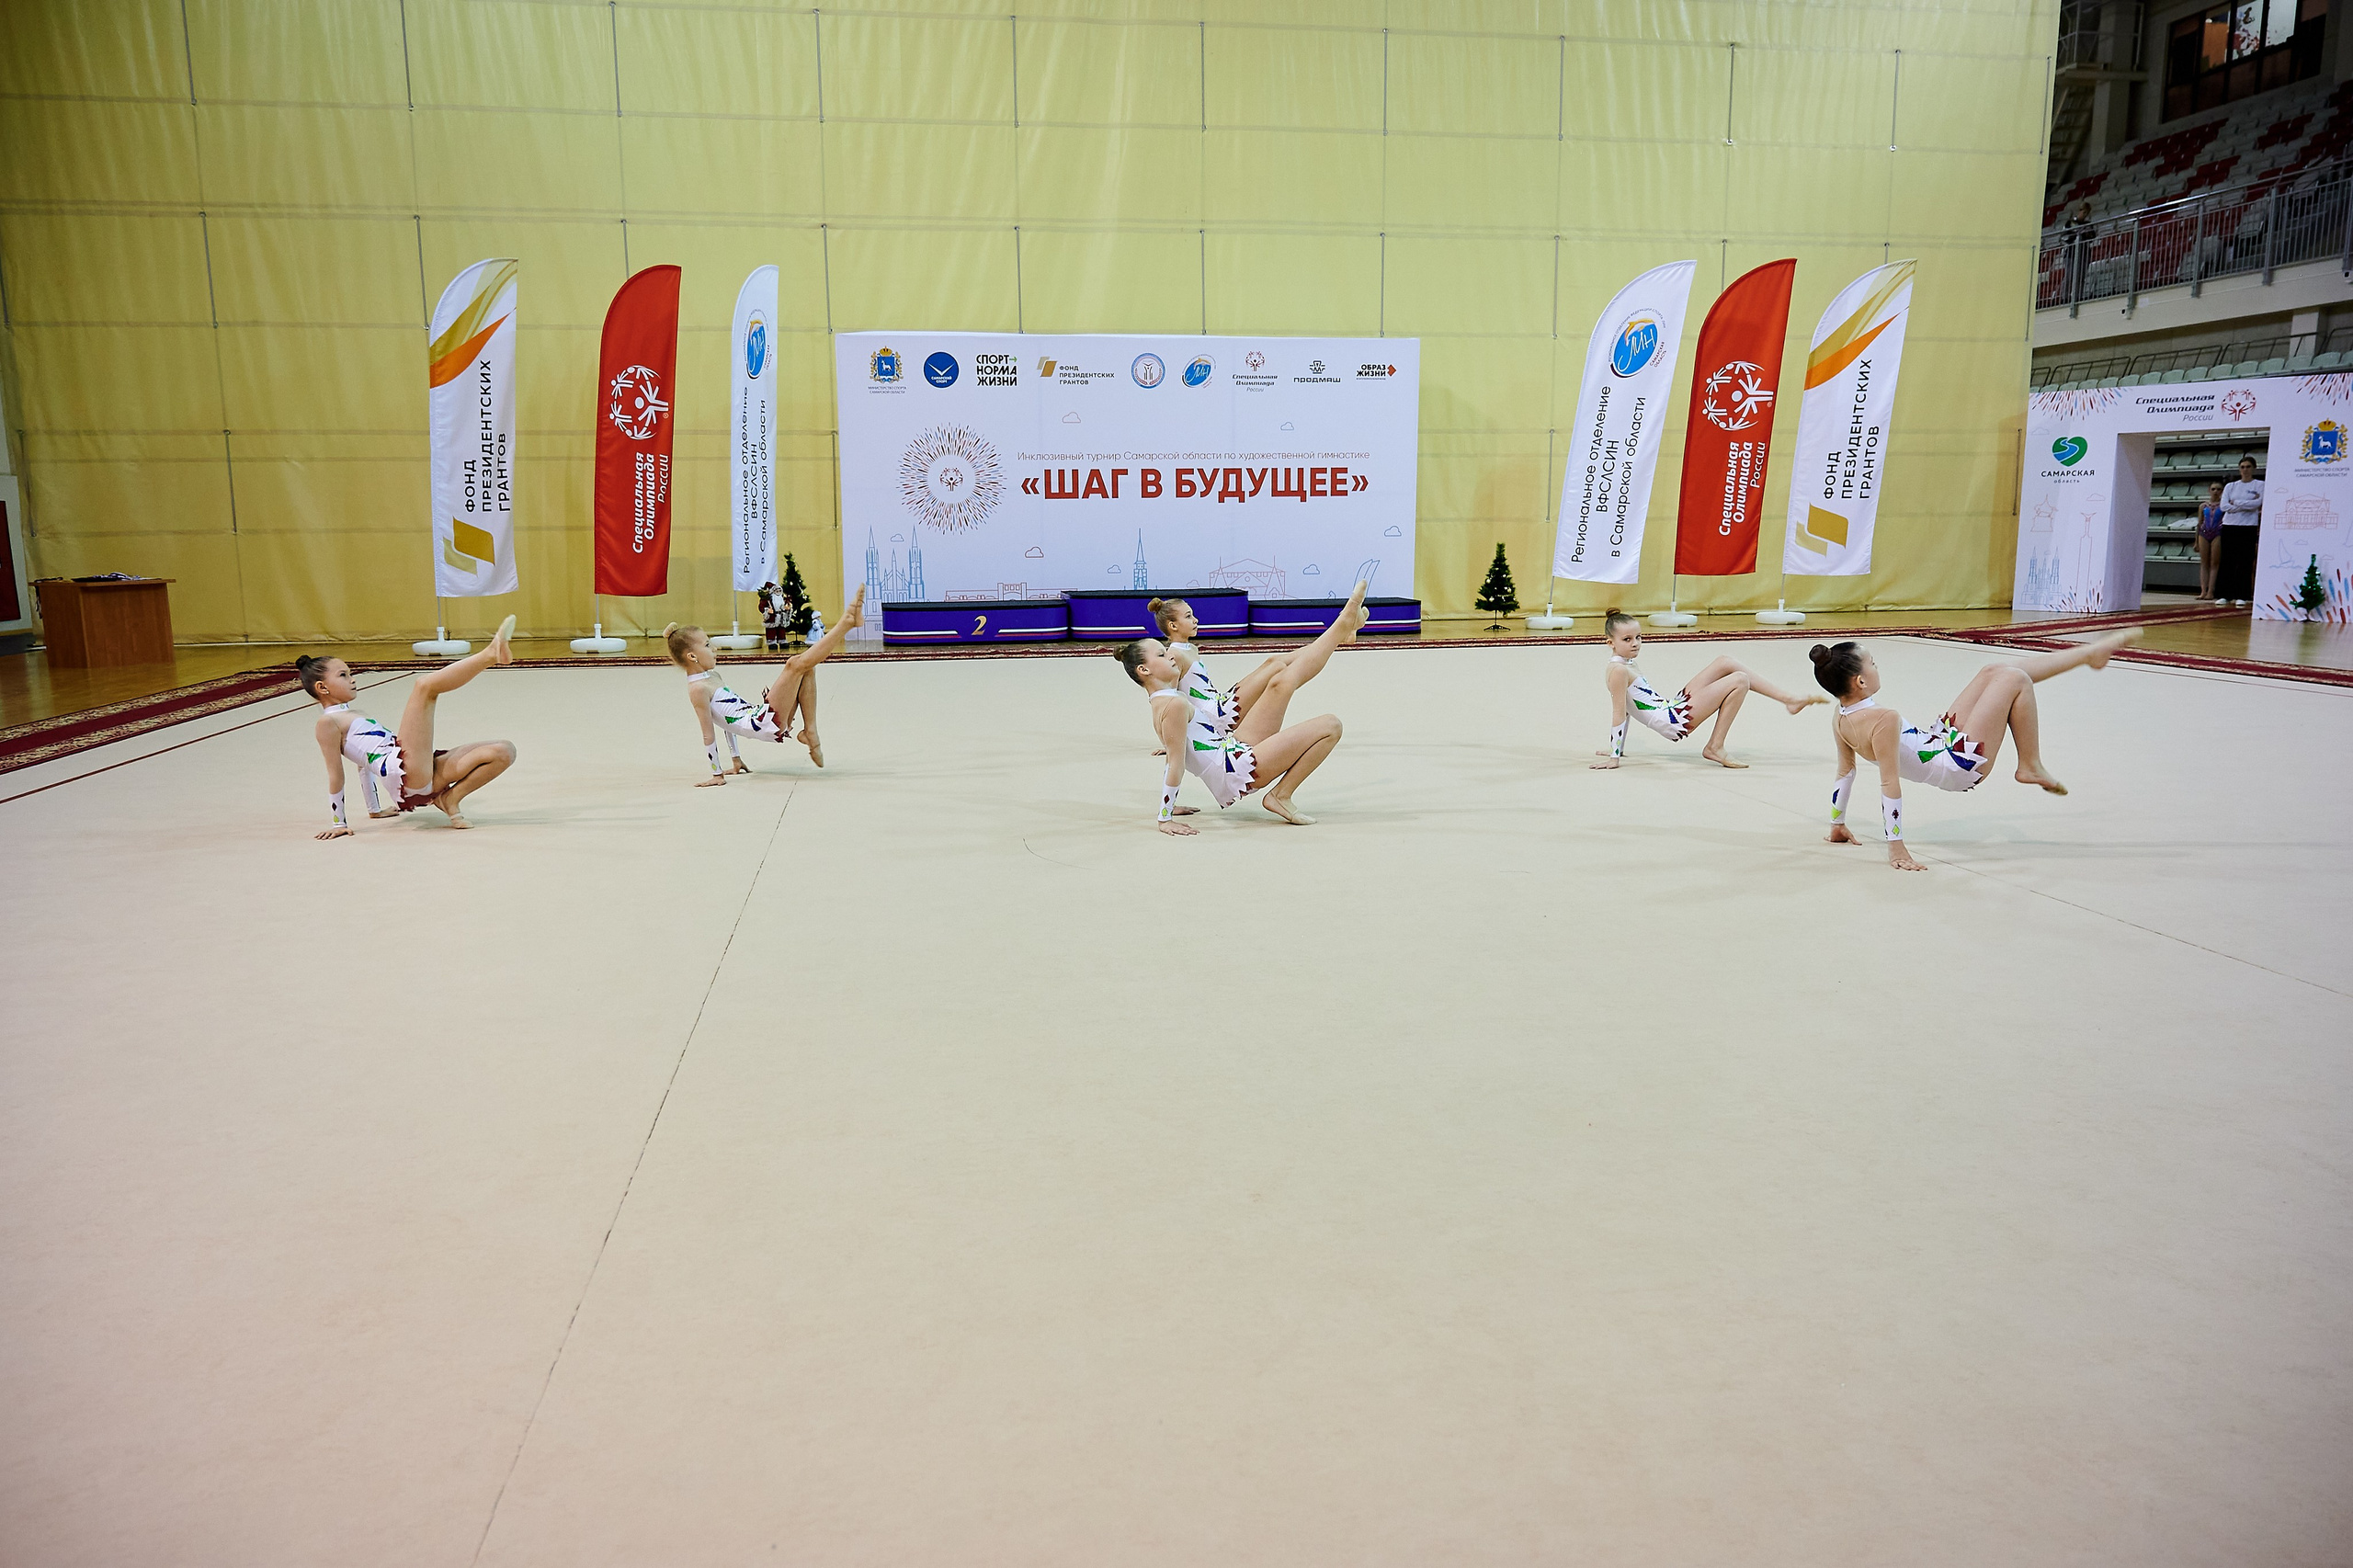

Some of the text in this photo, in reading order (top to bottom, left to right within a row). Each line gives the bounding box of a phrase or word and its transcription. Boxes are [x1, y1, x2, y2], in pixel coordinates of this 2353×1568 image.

[976, 355, 1010, 365] СПОРТ
[976, 366, 1017, 375] НОРМА
[977, 377, 1017, 386] ЖИЗНИ
[1841, 359, 1872, 499] ПРЕЗИДЕНТСКИХ
[2135, 394, 2215, 404] Специальная
[2146, 404, 2214, 414] Олимпиада
[2182, 414, 2213, 422] России
[480, 360, 494, 512] ПРЕЗИДЕНТСКИХ
[758, 400, 767, 460] области
[1017, 451, 1084, 460] Инклюзивный
[1087, 453, 1121, 461] турнир
[1124, 451, 1180, 461] Самарской
[1182, 450, 1222, 460] области
[1238, 450, 1315, 461] художественной
[1317, 451, 1370, 460] гимнастике
[464, 460, 477, 513] ФОНД
[496, 433, 511, 512] ГРАНТОВ
[657, 454, 668, 503] России
[750, 443, 758, 519] ВФСЛСИН
[1020, 467, 1370, 503] «ШАГ В БУДУЩЕЕ»
[1571, 386, 1611, 562] Региональное отделение
[1596, 440, 1620, 513] ВФСЛСИН
[1609, 460, 1633, 546] Самарской
[1625, 396, 1646, 457] области
[1719, 441, 1740, 536] Специальная
[1733, 441, 1753, 523] Олимпиада
[1750, 441, 1766, 488] России
[1824, 451, 1841, 499] ФОНД
[1859, 426, 1880, 498] ГРАНТОВ
[632, 451, 644, 553] Специальная
[643, 453, 655, 540] Олимпиада
[759, 465, 769, 552] Самарской
[971, 616, 987, 636] 2
